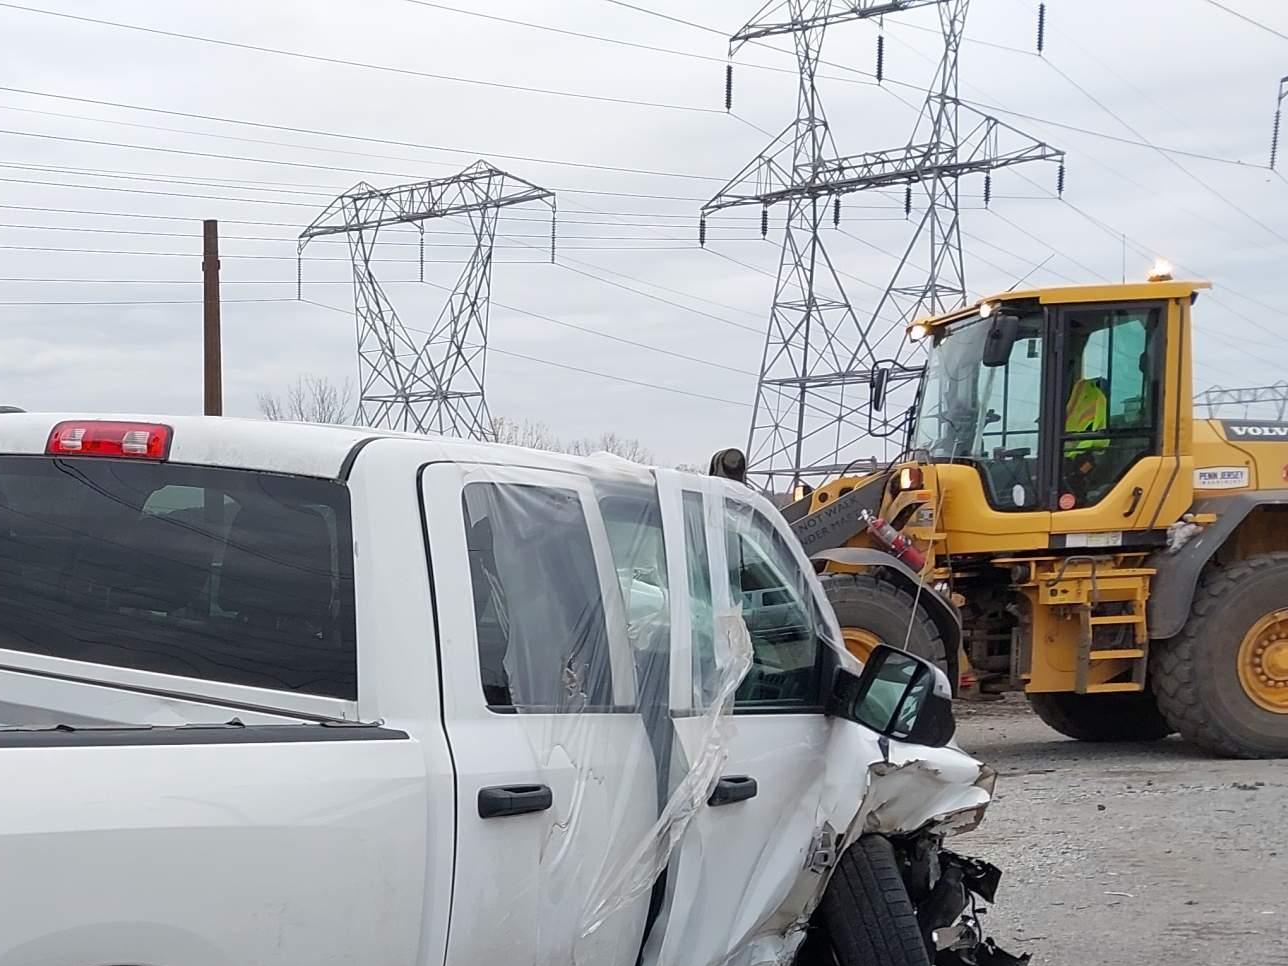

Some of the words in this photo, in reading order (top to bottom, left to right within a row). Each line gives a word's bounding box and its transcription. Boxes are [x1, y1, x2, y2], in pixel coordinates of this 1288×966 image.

[1199, 471, 1218, 480] PENN
[1221, 470, 1244, 480] JERSEY
[797, 514, 823, 533] NOT
[824, 495, 859, 518] WALK
[800, 526, 831, 546] NDER
